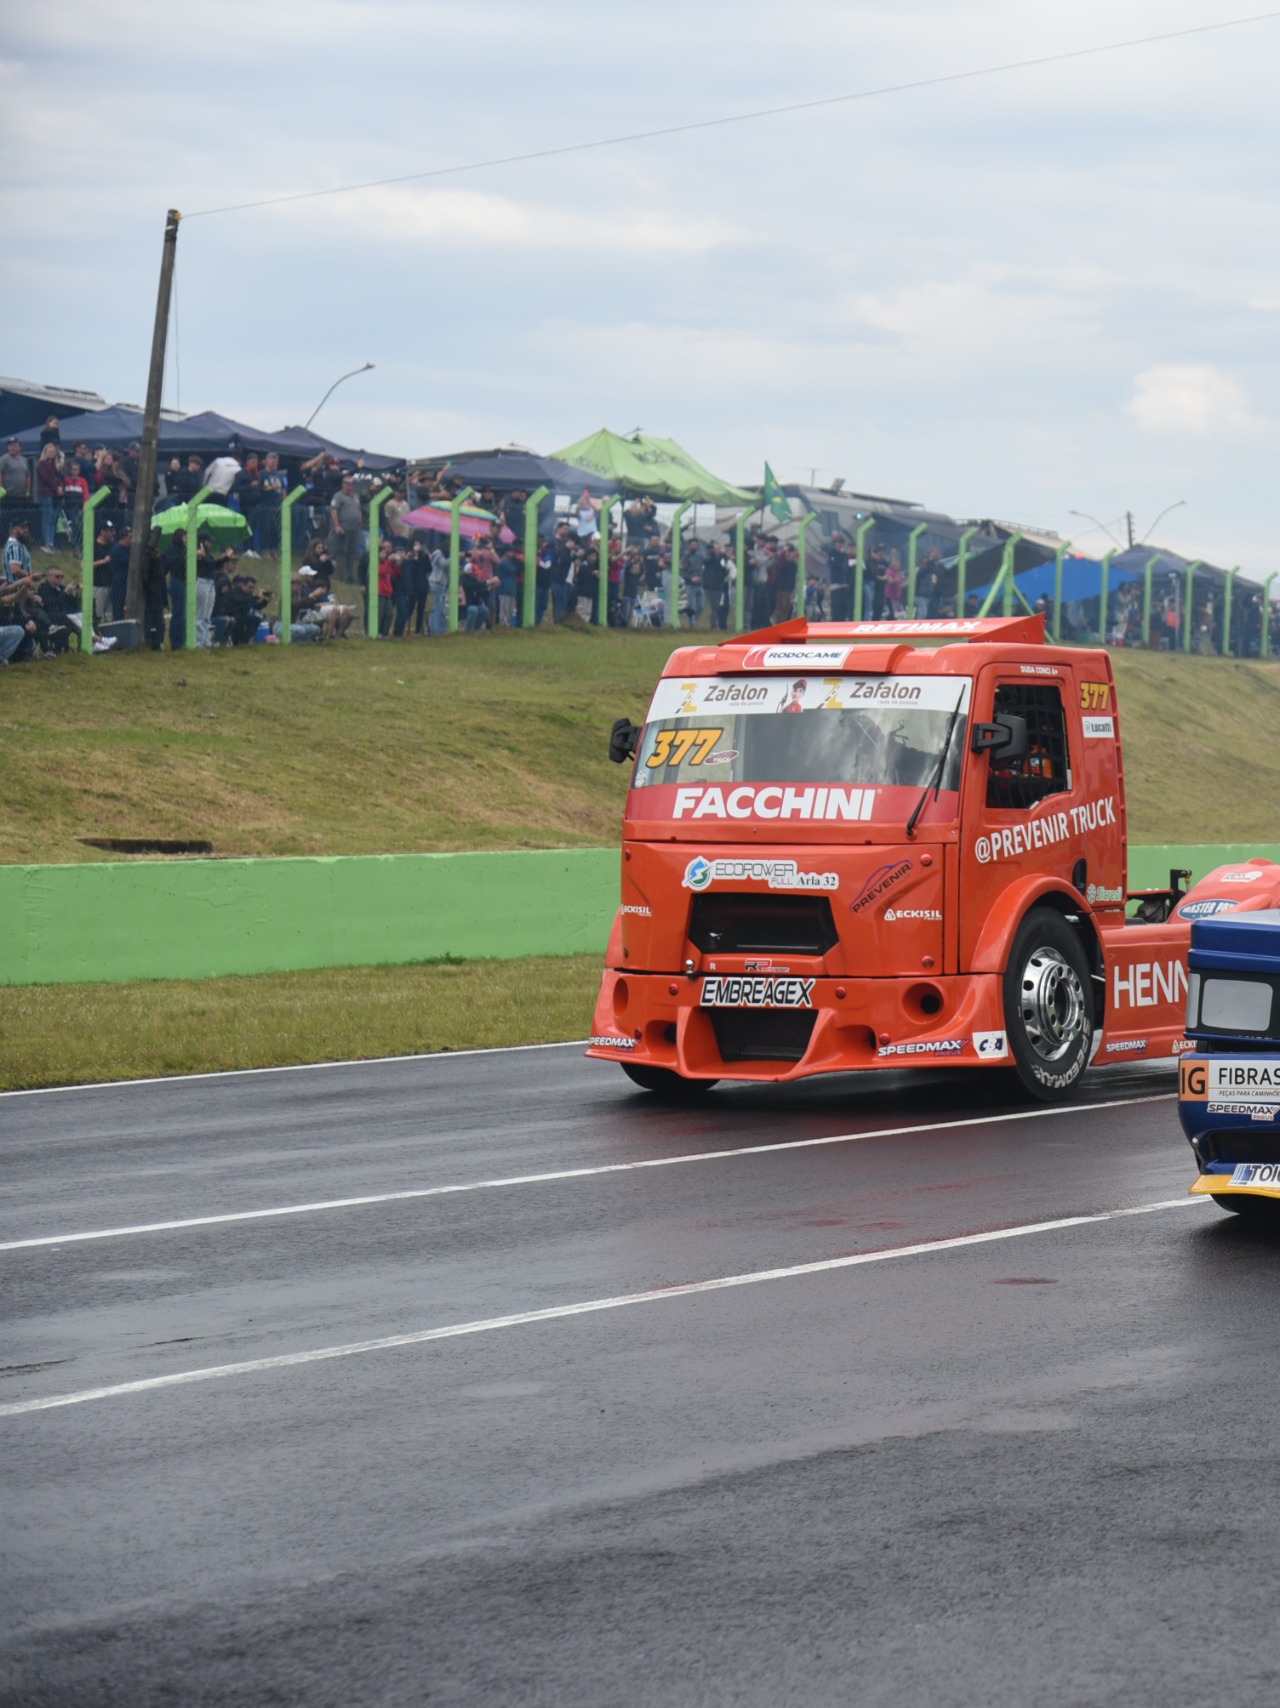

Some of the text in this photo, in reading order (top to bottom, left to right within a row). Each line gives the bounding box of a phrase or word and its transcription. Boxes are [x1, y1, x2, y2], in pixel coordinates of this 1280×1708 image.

[852, 620, 982, 634] RETIMAX
[768, 651, 842, 660] RODOCAME
[703, 684, 768, 702] Zafalon
[850, 682, 921, 700] Zafalon
[1080, 682, 1109, 709] 377
[645, 727, 723, 768] 377
[672, 787, 876, 821] FACCHINI
[975, 796, 1116, 864] @PREVENIR TRUCK
[715, 863, 794, 877] ECOPOWER
[771, 877, 793, 885] FULL
[798, 876, 836, 886] Arla 32
[852, 863, 912, 913] PREVENIR
[1096, 885, 1123, 902] Sicredi
[896, 910, 942, 919] ECKISIL
[1183, 903, 1216, 913] MASTER
[702, 980, 814, 1005] EMBREAGEX
[878, 1040, 961, 1056] SPEEDMAX
[1106, 1040, 1146, 1052] SPEEDMAX
[1181, 1067, 1206, 1094] IG
[1209, 1104, 1275, 1114] SPEEDMAX
